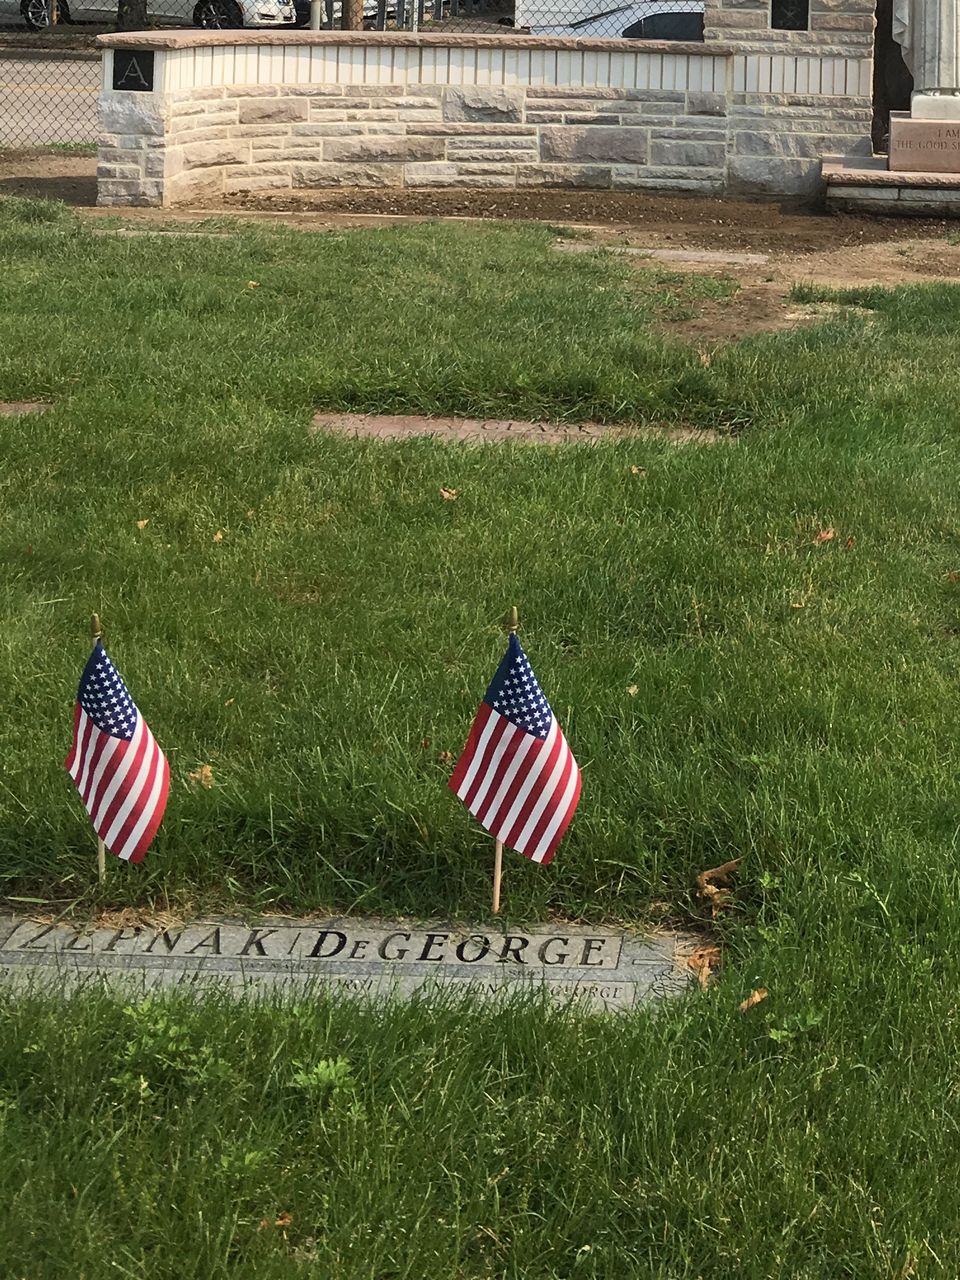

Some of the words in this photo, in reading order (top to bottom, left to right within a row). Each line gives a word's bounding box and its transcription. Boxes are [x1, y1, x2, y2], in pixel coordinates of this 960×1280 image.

[945, 129, 960, 138] AM
[896, 140, 913, 149] THE
[918, 140, 947, 150] GOOD
